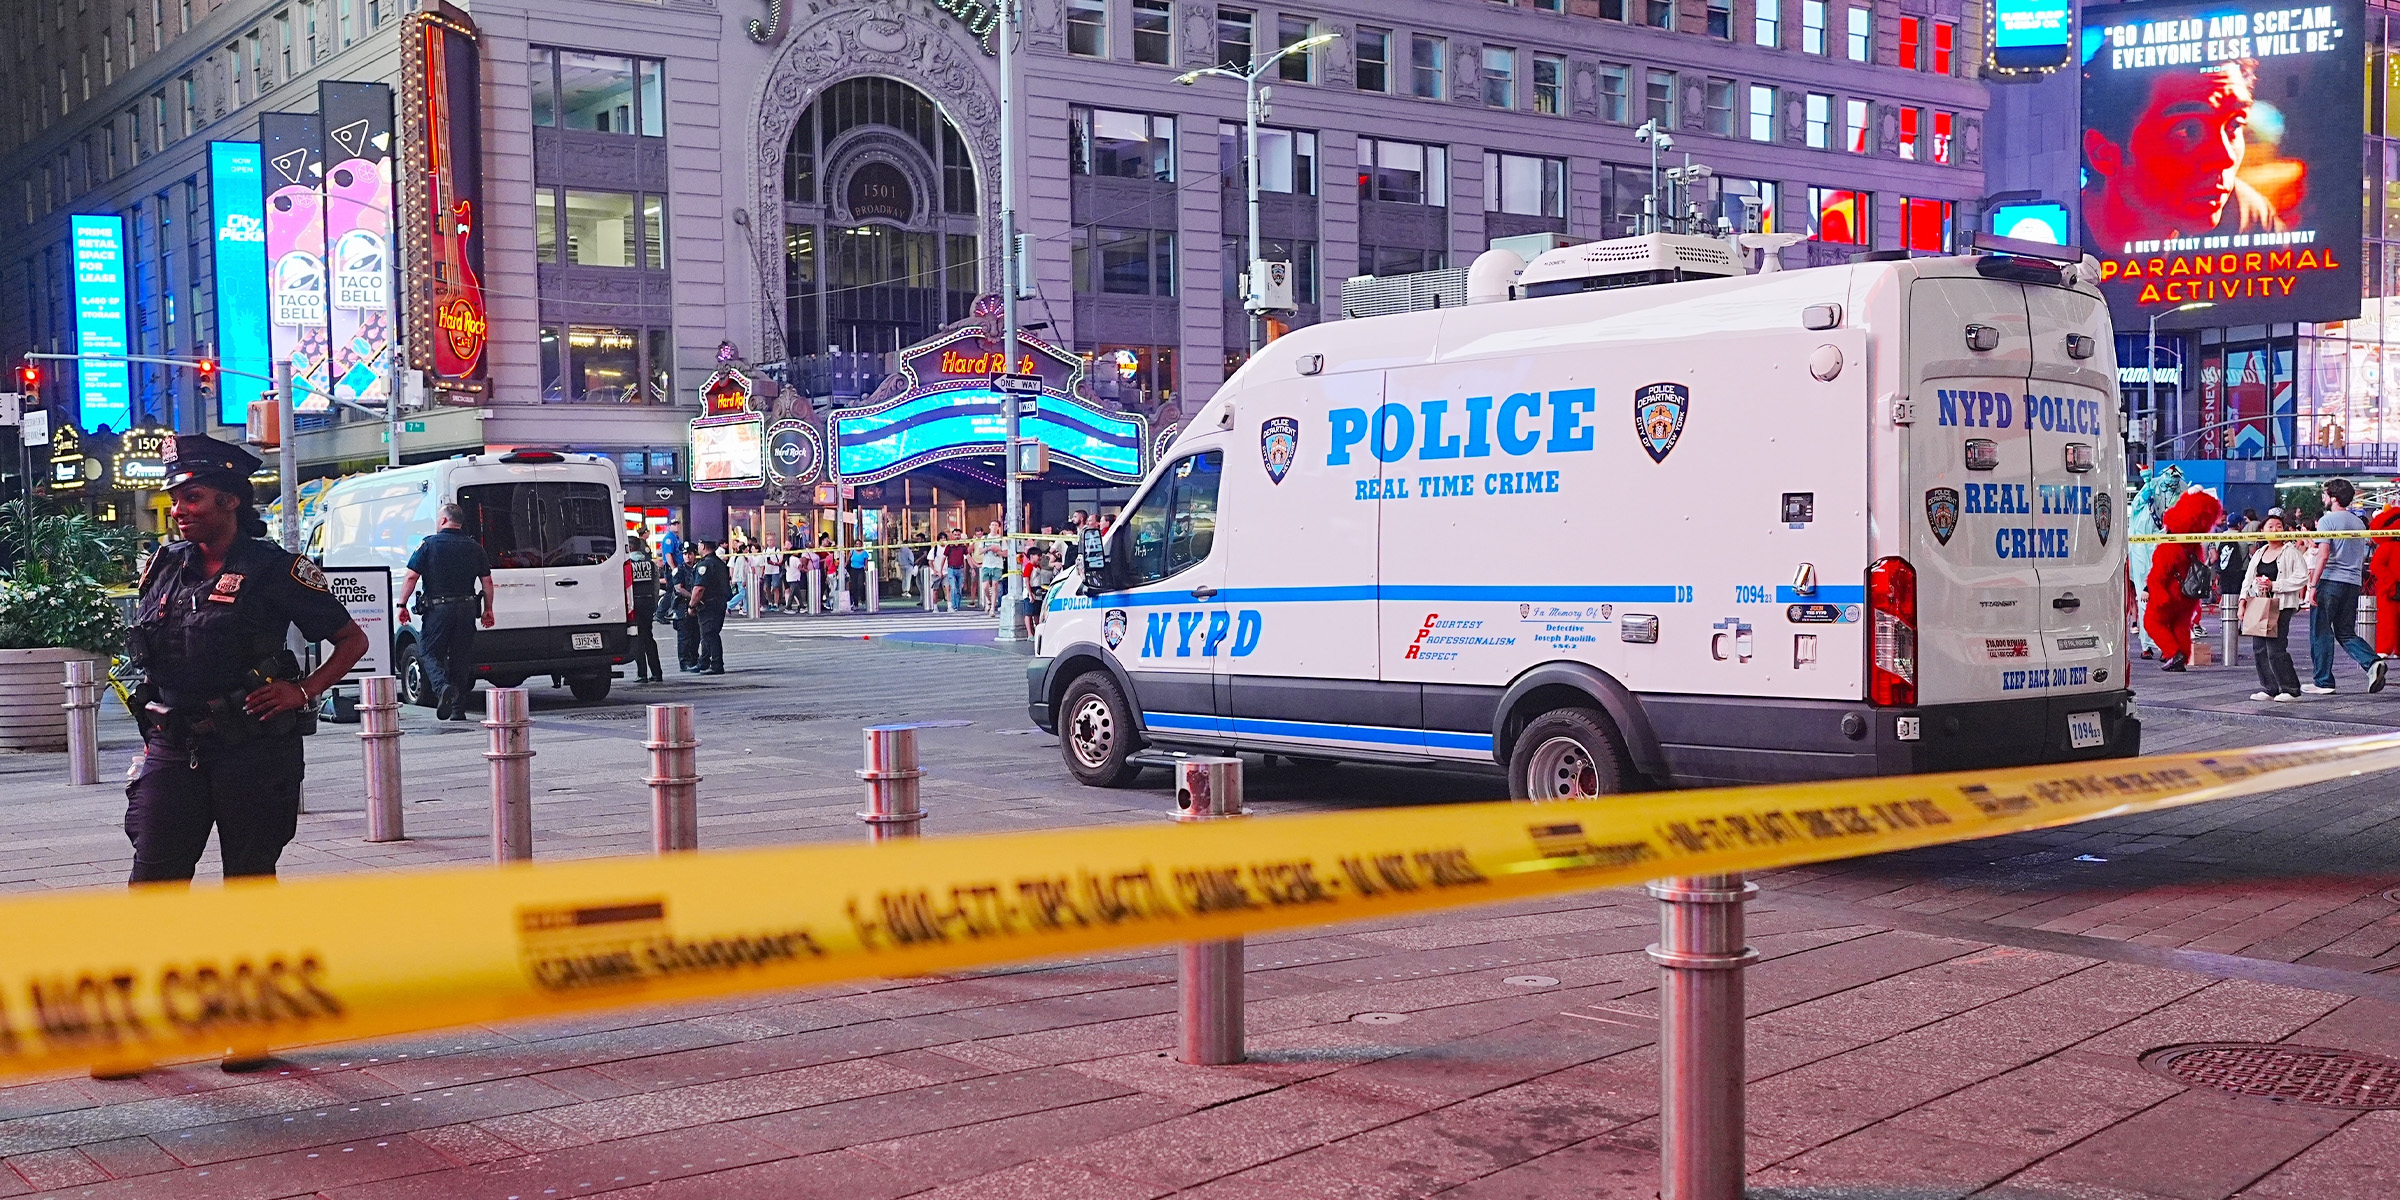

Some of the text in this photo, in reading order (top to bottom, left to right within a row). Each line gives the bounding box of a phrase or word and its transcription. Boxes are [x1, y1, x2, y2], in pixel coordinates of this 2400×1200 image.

[2142, 19, 2203, 44] AHEAD
[2208, 14, 2248, 38] AND
[2112, 42, 2202, 70] EVERYONE
[2208, 38, 2250, 61] ELSE
[2256, 34, 2300, 56] WILL
[864, 184, 895, 198] 1501
[855, 204, 905, 218] BROADWAY
[227, 214, 260, 232] City
[78, 228, 112, 237] PRIME
[78, 240, 118, 248] RETAIL
[2124, 230, 2316, 254] A NEW STORY NOW ON BROADWAY
[79, 251, 114, 260] SPACE
[2101, 249, 2339, 280] PARANORMAL
[80, 274, 116, 282] LEASE
[339, 276, 382, 288] TACO
[341, 291, 381, 302] BELL
[2140, 276, 2296, 302] ACTIVITY
[279, 294, 320, 306] TACO
[281, 308, 318, 319] BELL
[439, 306, 486, 340] Hard Rock
[942, 351, 988, 373] Hard
[1001, 379, 1015, 387] ONE
[1649, 385, 1674, 394] POLICE
[718, 393, 735, 409] Hard
[1638, 393, 1685, 409] DEPARTMENT
[1938, 390, 2100, 435] NYPD POLICE
[1263, 426, 1296, 438] DEPARTMENT
[1327, 388, 1595, 466] POLICE
[1636, 416, 1651, 447] CITY OF
[1666, 411, 1685, 450] NEW YORK
[2205, 414, 2214, 440] CBS
[775, 448, 806, 458] Hard Rock
[1355, 471, 1559, 500] REAL TIME CRIME
[1965, 484, 2029, 514] REAL
[2040, 485, 2092, 515] TIME
[1996, 528, 2068, 559] CRIME
[632, 562, 652, 571] NYPD
[331, 585, 367, 594] times
[1678, 586, 1772, 603] DB 7094 23
[1062, 597, 1092, 610] POLICE
[1424, 613, 1483, 629] COURTESY
[1534, 607, 1598, 620] In Memory Of
[1141, 610, 1262, 657] NYPD
[1414, 629, 1515, 646] PROFESSIONALISM
[1405, 645, 1458, 660] RESPECT
[2003, 671, 2026, 690] KEEP
[2028, 669, 2049, 689] BACK
[2053, 668, 2067, 687] 200
[2070, 667, 2087, 685] FEET
[2073, 722, 2093, 740] 7094
[158, 950, 346, 1037] CROSS
